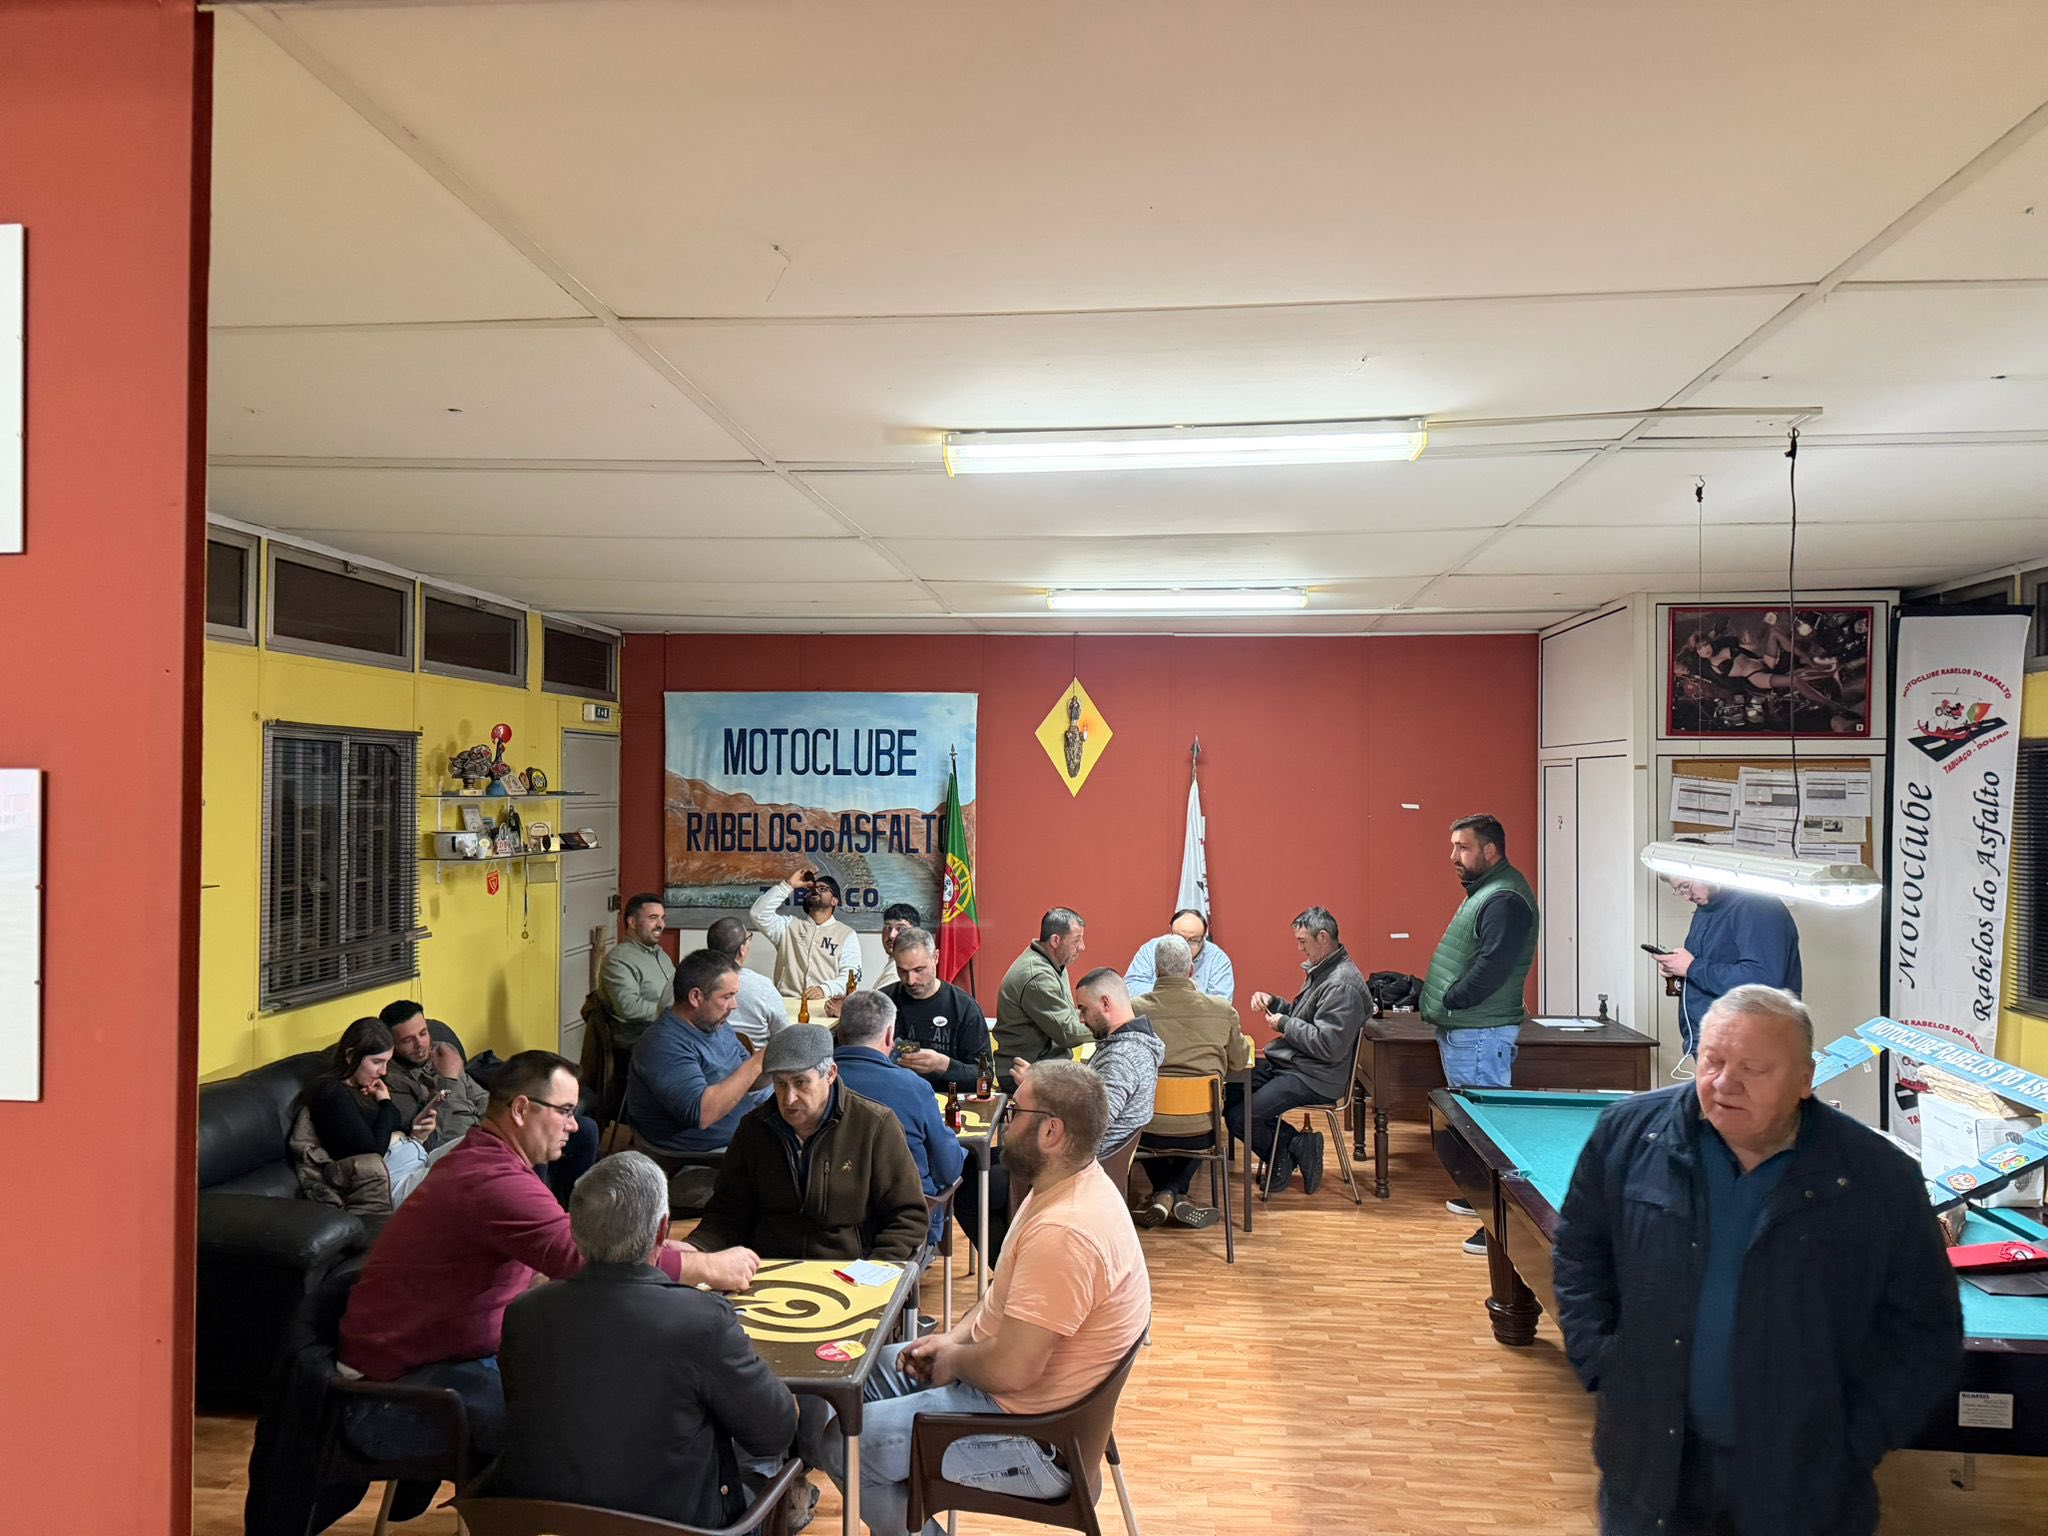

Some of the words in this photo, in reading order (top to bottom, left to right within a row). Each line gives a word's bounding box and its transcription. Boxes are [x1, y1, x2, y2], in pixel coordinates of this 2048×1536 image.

[1940, 667, 1972, 676] RABELOS
[1972, 669, 1983, 678] DO
[1982, 673, 2012, 700] ASFALTO
[723, 728, 917, 777] MOTOCLUBE
[1942, 750, 1973, 775] TABUAÇO
[1976, 730, 2010, 750] DOURO
[686, 812, 802, 852] RABELOS
[804, 829, 835, 853] DO
[1972, 770, 2006, 877] Asfalto
[1898, 781, 1933, 990] Motoclube
[1972, 879, 1998, 913] do
[820, 936, 838, 956] NY
[1971, 918, 1995, 1022] Rabelos
[1867, 1020, 1944, 1057] MOTOCLUBE
[1936, 1043, 2005, 1078] RABELOS
[1995, 1067, 2026, 1087] DO
[1952, 1026, 1965, 1036] DO
